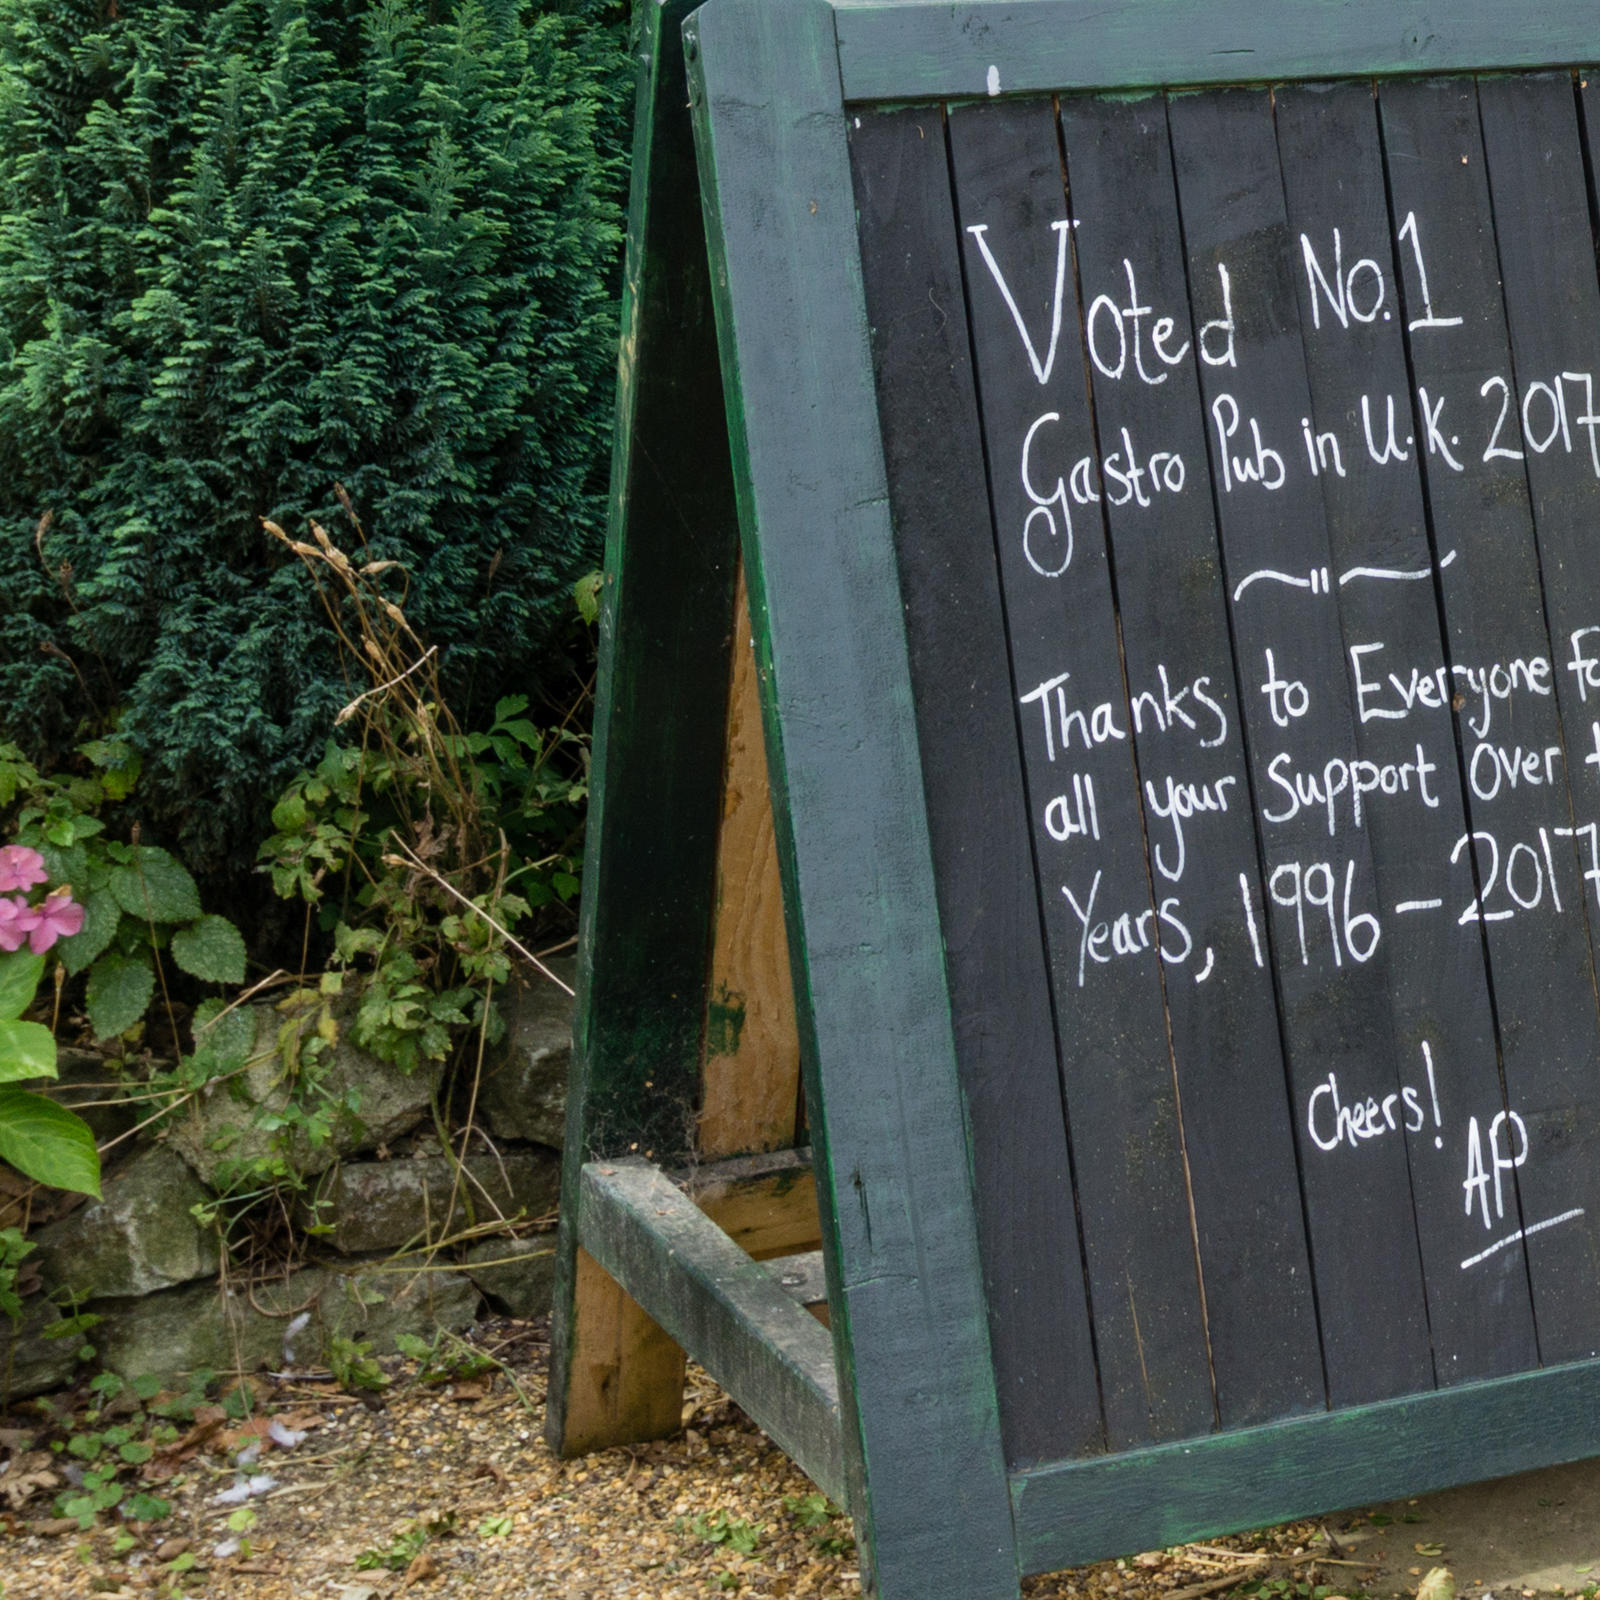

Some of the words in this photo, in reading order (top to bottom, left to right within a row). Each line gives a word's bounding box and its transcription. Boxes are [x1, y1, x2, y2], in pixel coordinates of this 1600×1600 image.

[966, 220, 1238, 385] Voted
[1021, 411, 1186, 578] Gastro
[1211, 393, 1286, 493] Pub
[1301, 417, 1347, 478] in
[1019, 663, 1228, 762] Thanks
[1260, 647, 1310, 728] to
[1349, 641, 1551, 739] Everyone
[1044, 773, 1101, 842] all
[1145, 775, 1236, 883] your
[1262, 743, 1440, 836] Support
[1469, 742, 1564, 801] Over
[1061, 869, 1215, 987] Years,
[1307, 1040, 1443, 1151] Cheers!
[1462, 1110, 1529, 1230] AP
